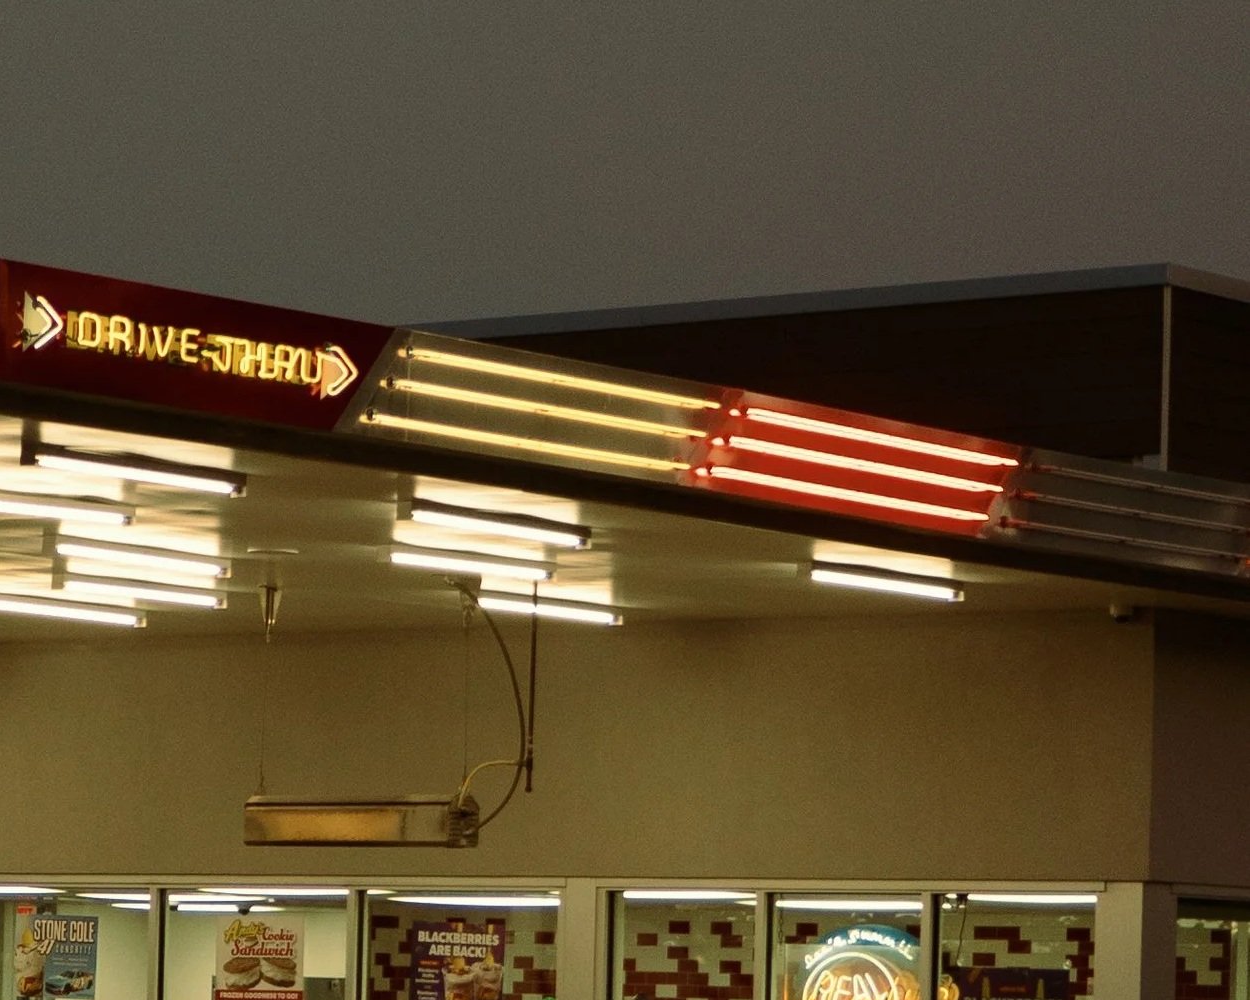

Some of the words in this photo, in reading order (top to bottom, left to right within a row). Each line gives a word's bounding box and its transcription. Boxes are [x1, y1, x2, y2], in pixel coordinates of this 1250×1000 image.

[34, 919, 67, 942] STONE
[69, 920, 95, 943] COLE
[262, 927, 295, 941] Cookie
[418, 930, 500, 946] BLACKBERRIES
[231, 939, 294, 956] Sandwich
[428, 944, 452, 957] ARE
[452, 945, 487, 959] BACK!
[220, 991, 244, 1000] FROZEN
[244, 992, 277, 1000] GOODNESS
[278, 992, 286, 1000] TO
